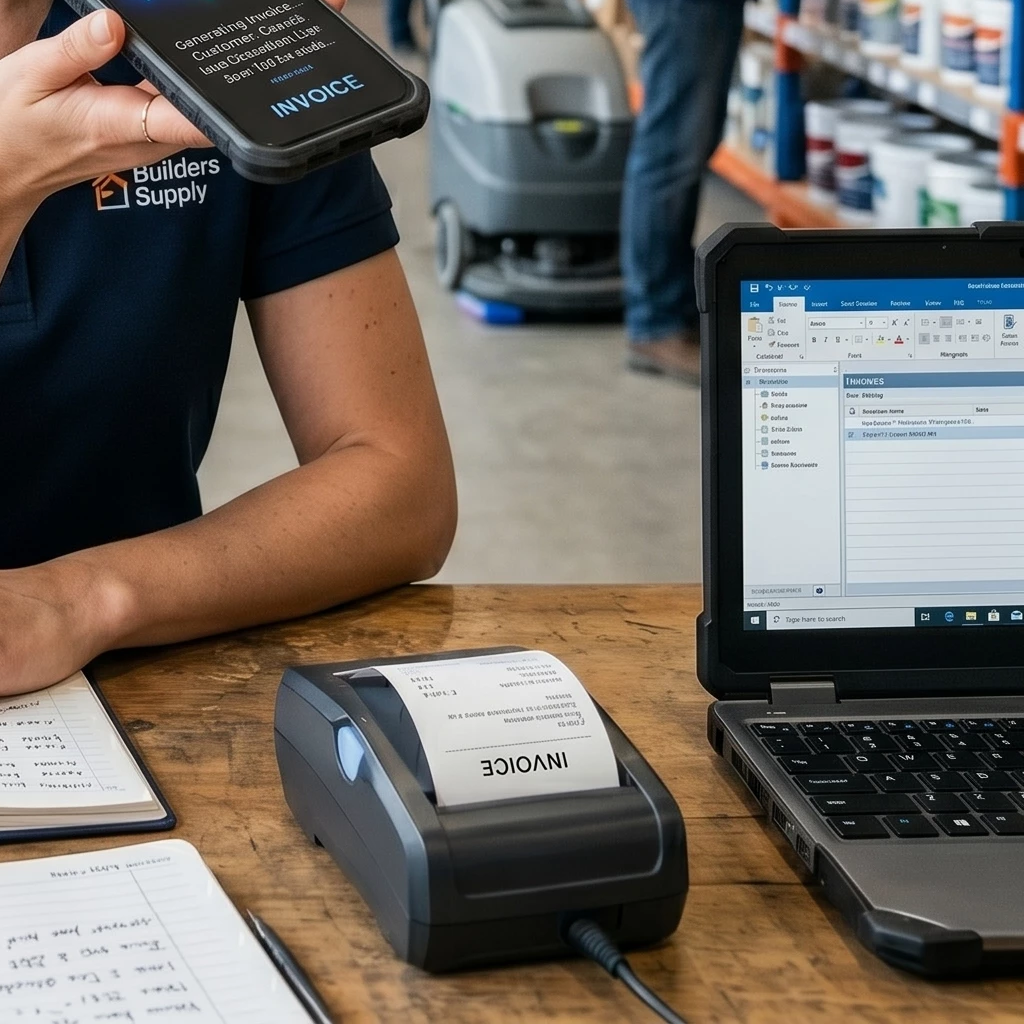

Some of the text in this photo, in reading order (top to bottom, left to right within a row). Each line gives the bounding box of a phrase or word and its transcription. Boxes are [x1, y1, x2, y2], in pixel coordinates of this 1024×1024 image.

[270, 74, 365, 118] INVOICE
[133, 157, 220, 183] Builders
[135, 181, 207, 209] Supply
[480, 751, 568, 776] INVOICE
